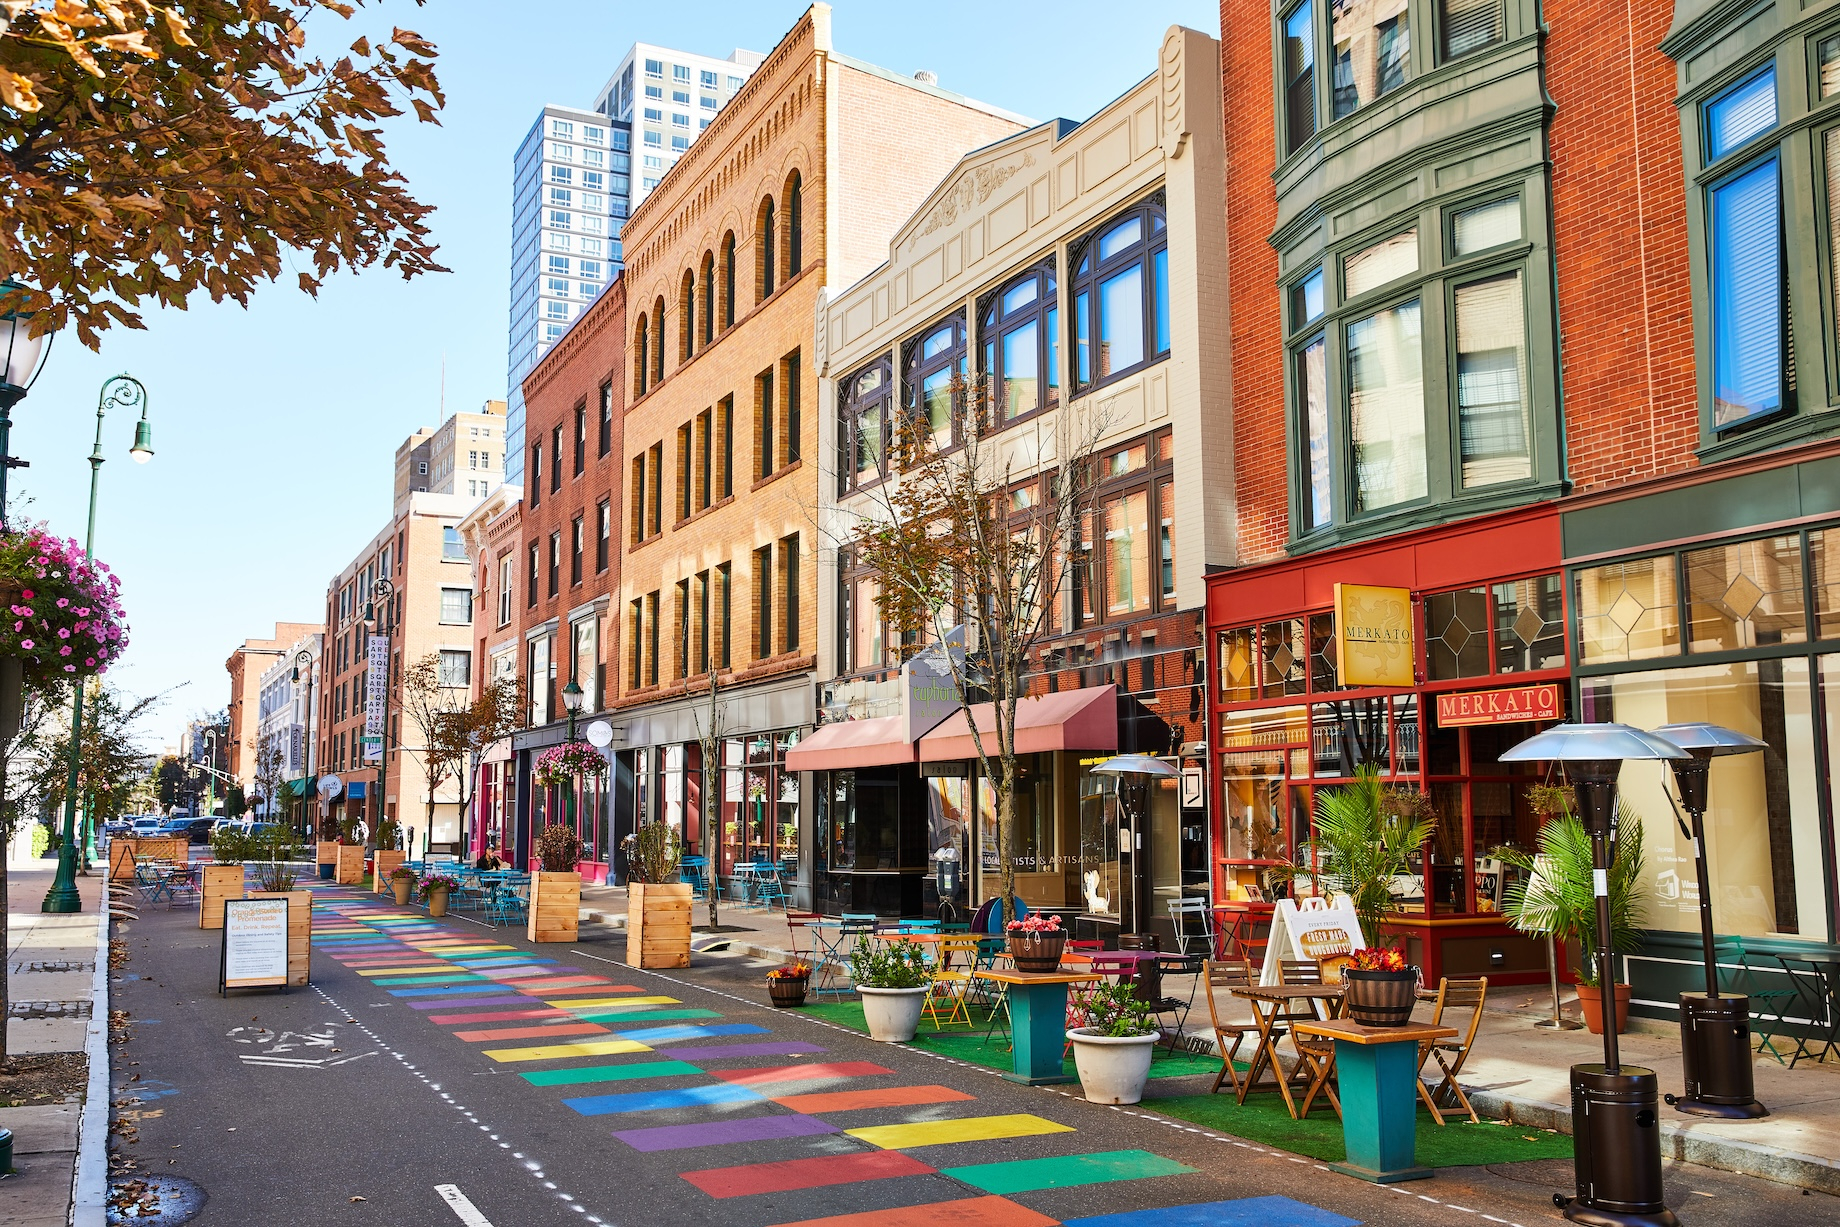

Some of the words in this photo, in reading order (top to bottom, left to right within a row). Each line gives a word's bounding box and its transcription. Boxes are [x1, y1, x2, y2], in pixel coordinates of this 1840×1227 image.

[1346, 626, 1410, 640] MERKATO
[914, 677, 961, 708] euphoria
[1442, 688, 1553, 717] MERKATO
[1497, 711, 1533, 721] SANDWICHES
[1049, 855, 1100, 864] ARTISANS
